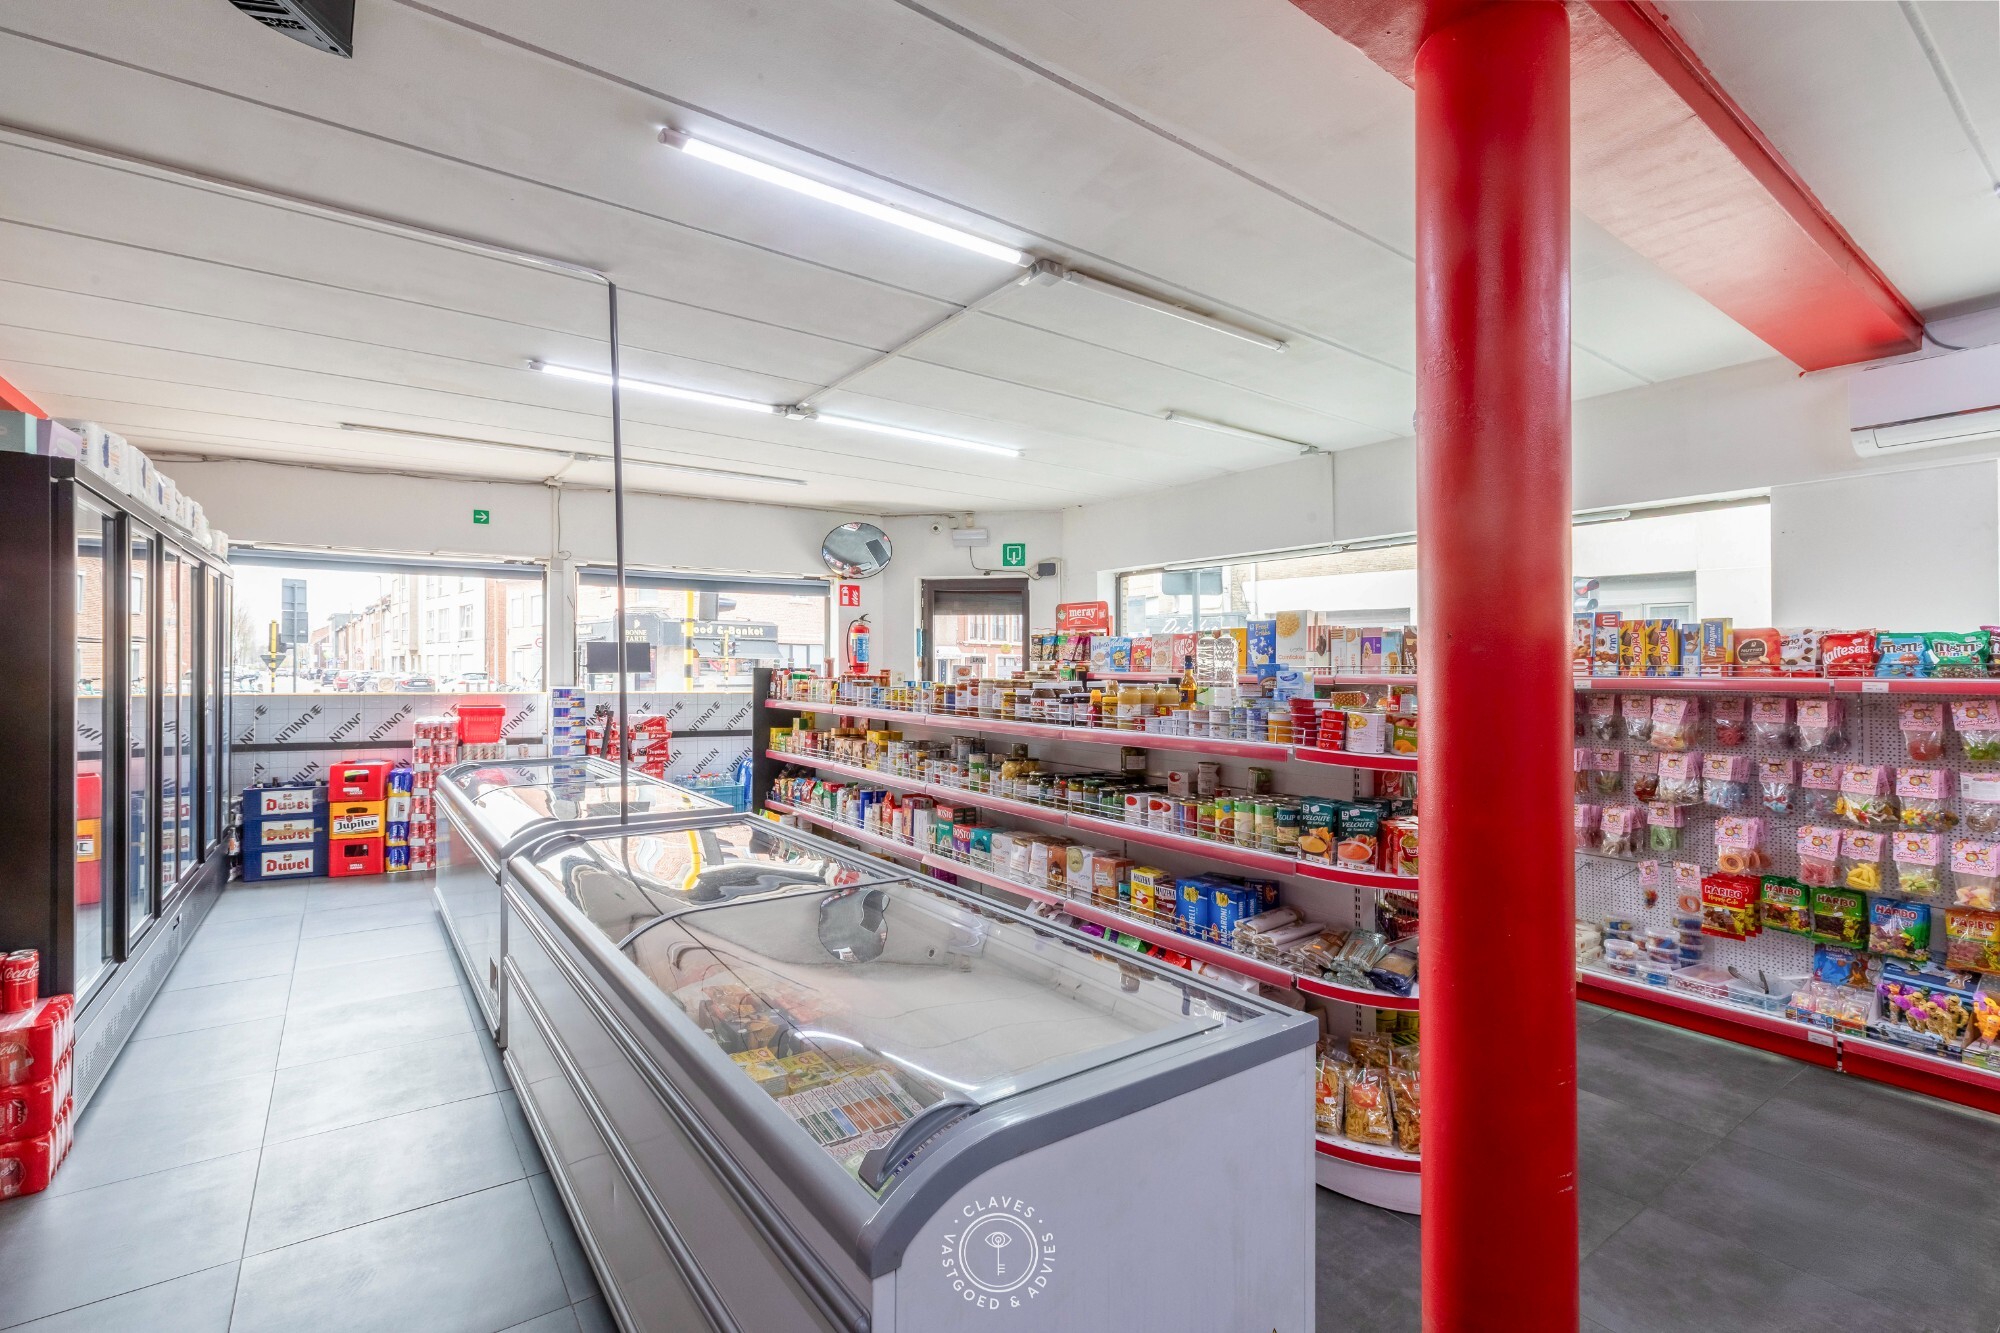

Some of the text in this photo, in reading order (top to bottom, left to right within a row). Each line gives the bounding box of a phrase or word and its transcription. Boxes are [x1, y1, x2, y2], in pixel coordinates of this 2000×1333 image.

[1069, 608, 1096, 618] meray
[681, 624, 713, 634] Bood
[1823, 645, 1869, 666] altesers
[369, 712, 405, 742] UNILIN
[689, 708, 716, 732] UNILIN
[275, 713, 314, 744] UNILIN
[663, 749, 682, 771] NILIN
[693, 748, 720, 775] UNILIN
[337, 819, 377, 830] Jupiler
[1302, 814, 1331, 822] VELOUTÉ
[266, 857, 310, 872] Duvel
[1704, 884, 1742, 899] HARIBO
[1765, 884, 1801, 897] HARIBO
[1817, 894, 1857, 908] HARIBO
[1875, 904, 1918, 920] HARIBO
[1220, 907, 1228, 945] MACARONI
[1950, 917, 1995, 931] HARIBO
